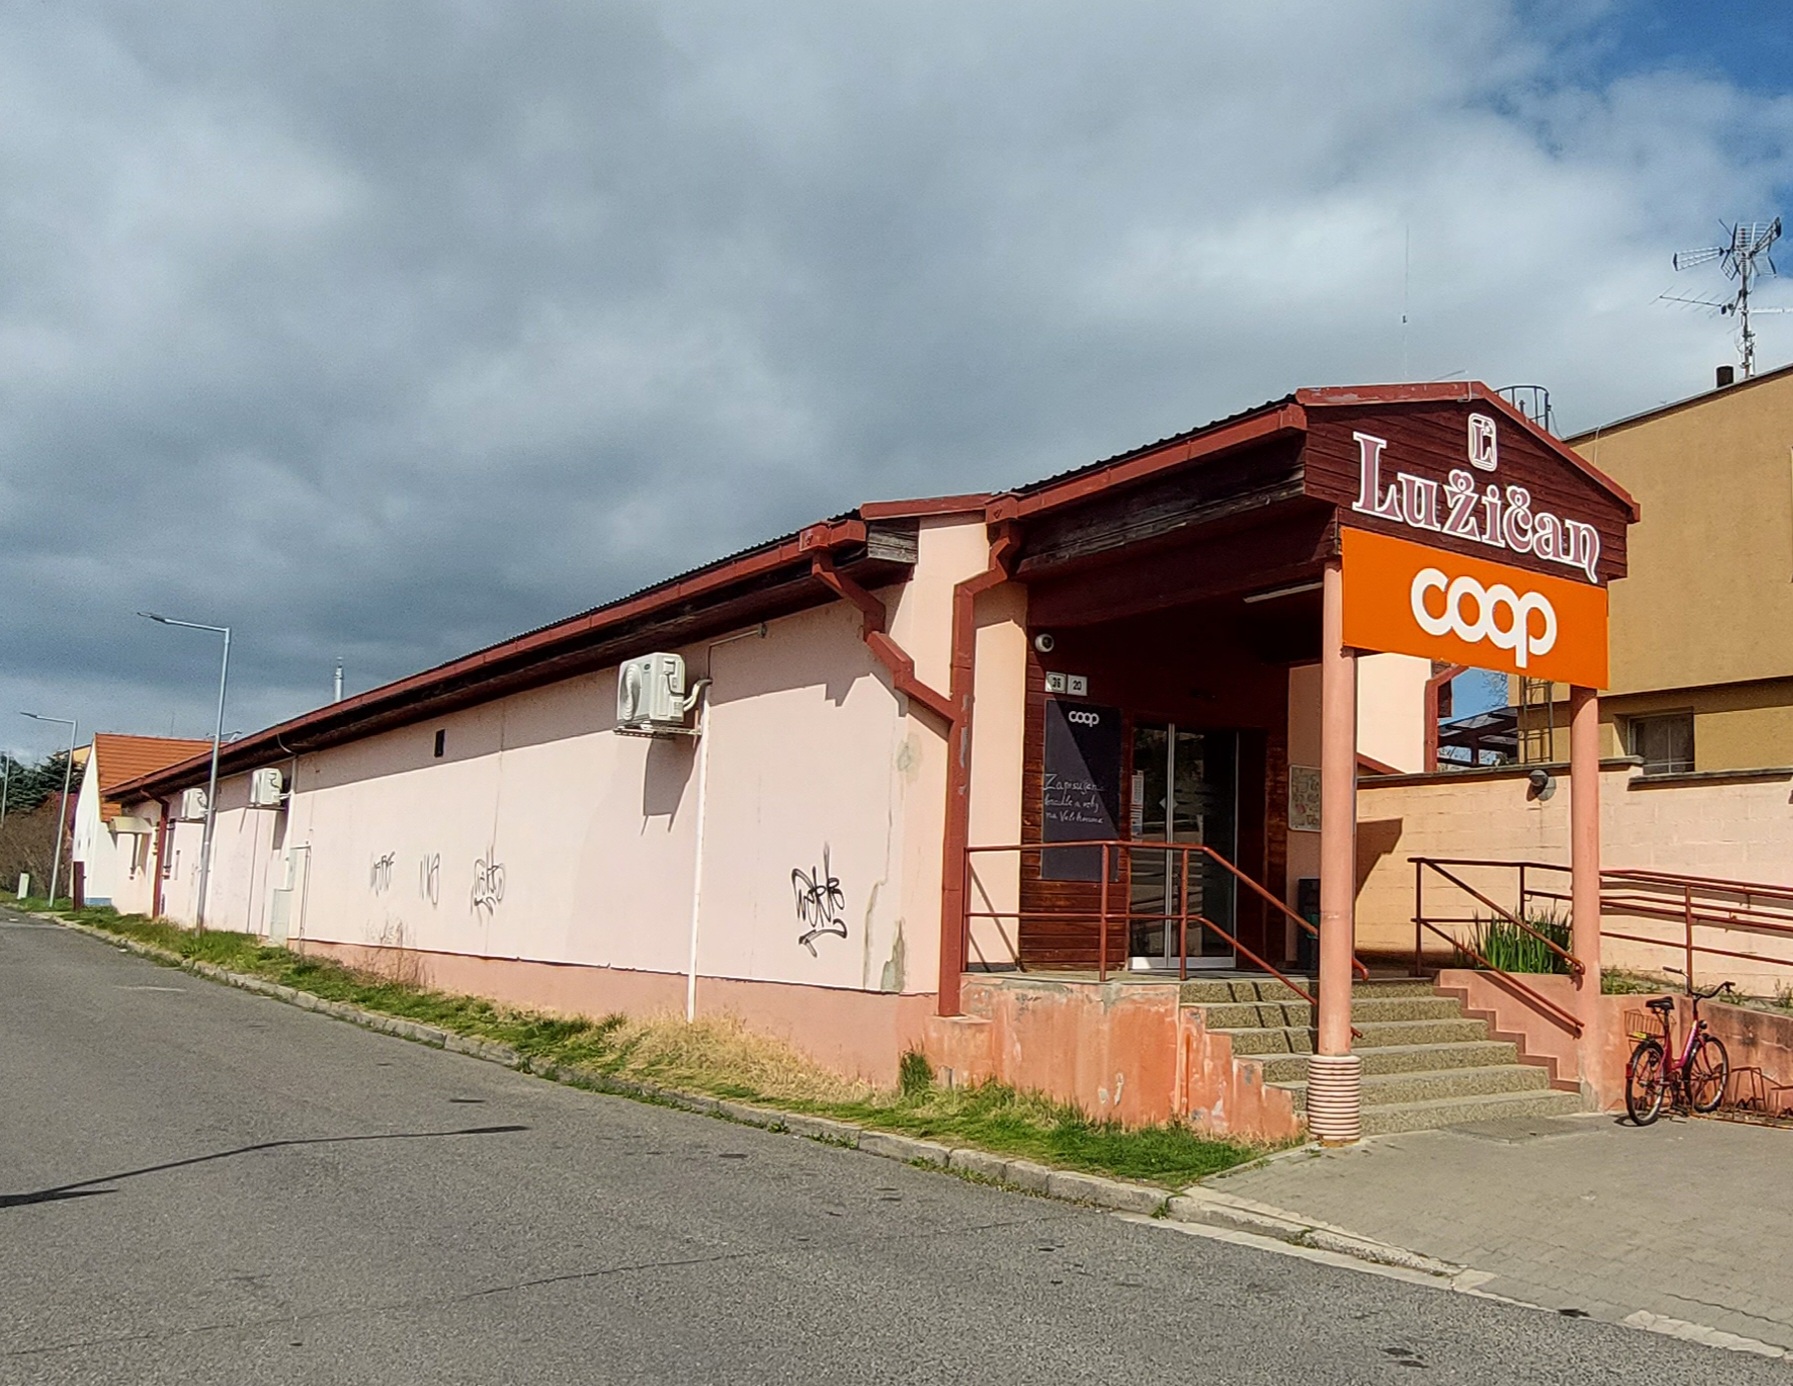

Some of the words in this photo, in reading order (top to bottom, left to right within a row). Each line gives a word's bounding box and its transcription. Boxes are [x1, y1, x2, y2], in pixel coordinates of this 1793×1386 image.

[1352, 431, 1600, 584] Lužičan
[1410, 567, 1557, 668] coop
[1072, 679, 1083, 691] 20
[1068, 710, 1100, 728] coop
